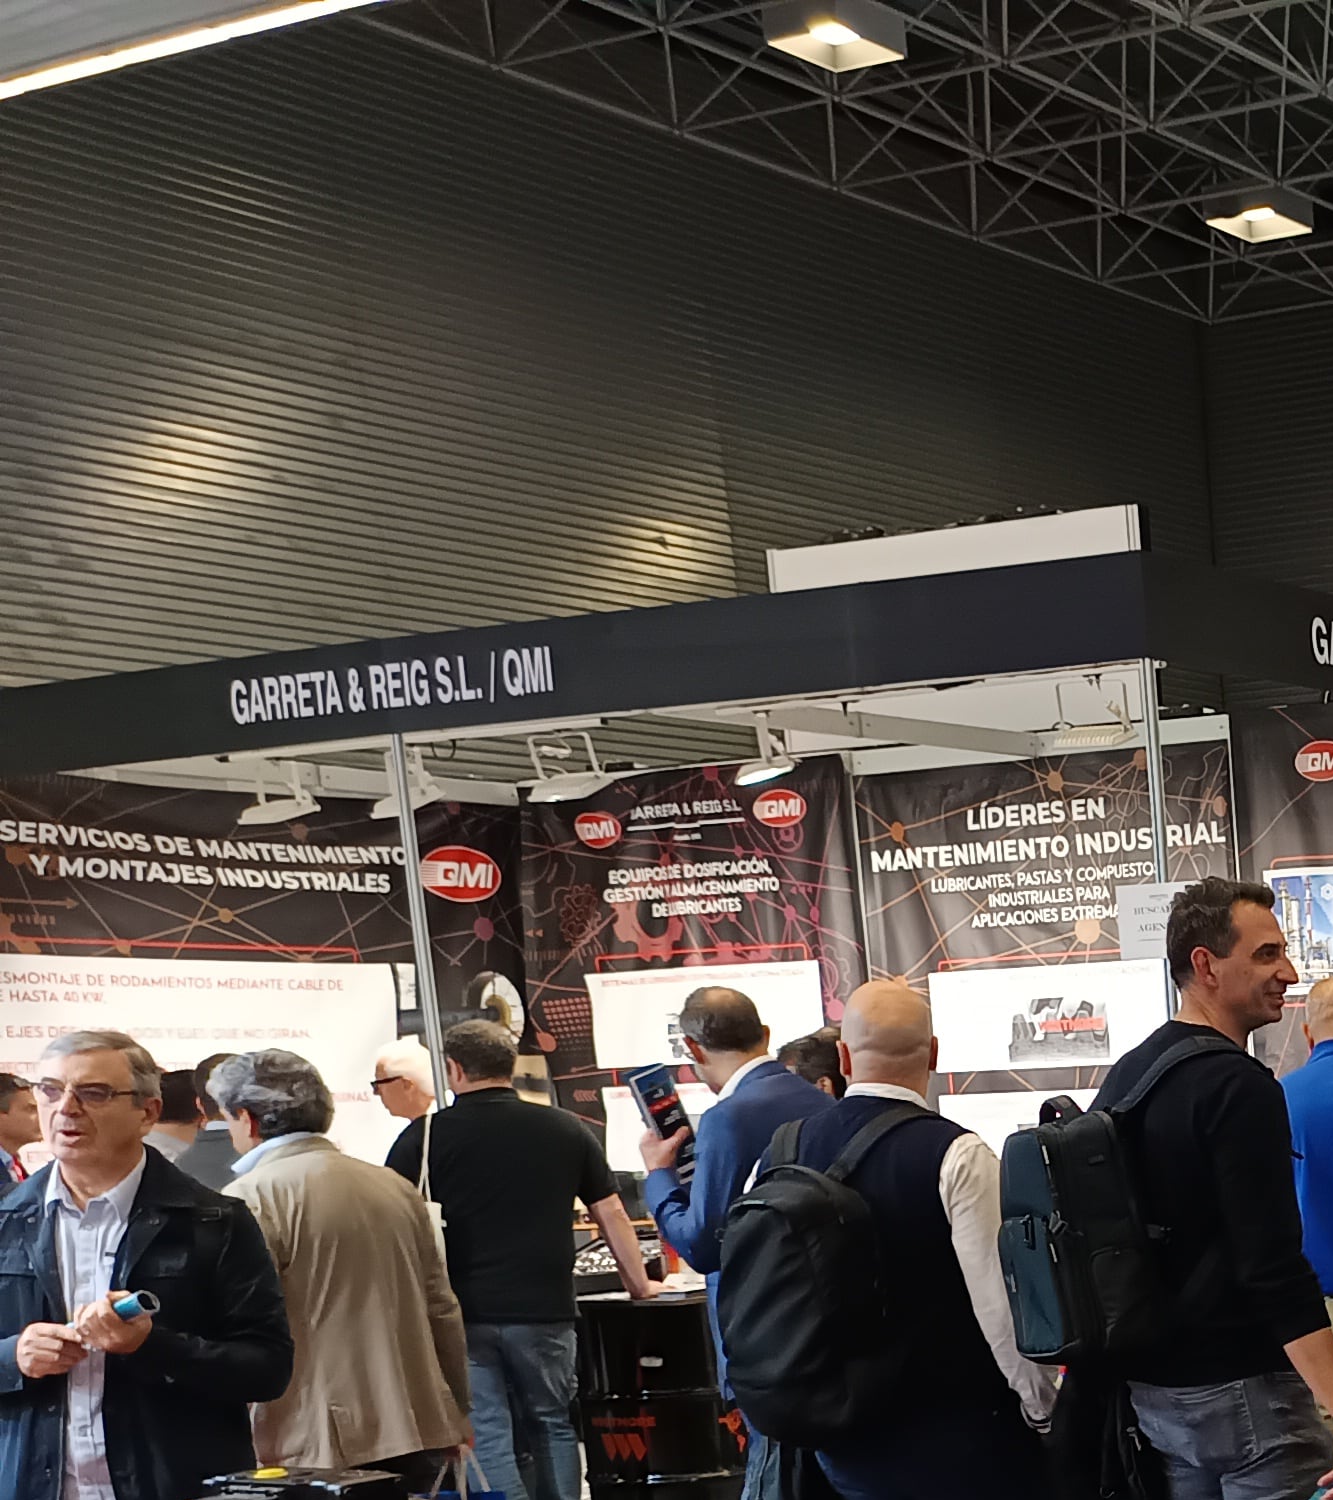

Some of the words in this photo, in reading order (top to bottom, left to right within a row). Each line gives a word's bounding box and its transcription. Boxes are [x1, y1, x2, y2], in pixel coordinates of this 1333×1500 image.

[229, 670, 345, 725] GARRETA
[347, 667, 367, 713] &
[368, 659, 431, 710] REIG
[434, 655, 484, 704] S.L.
[502, 646, 554, 697] QMI
[765, 798, 801, 818] QMI
[965, 799, 1066, 832] LÍDERES
[1070, 797, 1106, 822] EN
[0, 819, 152, 853] SERVICIOS
[153, 834, 195, 857] DE
[199, 837, 406, 866] MANTENIMIENTO
[870, 835, 1070, 873] MANTENIMIENTO
[1075, 820, 1227, 854] INDUSRIAL
[28, 853, 51, 876] Y
[58, 855, 216, 886] MONTAJES
[217, 866, 392, 894] INDUSTRIALES
[435, 860, 494, 890] QMI
[608, 865, 667, 886] EQUIPOS
[930, 871, 1016, 894] LUBRICANTES,
[1016, 868, 1062, 888] PASTAS
[1064, 868, 1074, 883] Y
[603, 882, 664, 904] GESTIÓN
[672, 877, 780, 898] ALMACENAMIENTO
[987, 887, 1074, 909] INDUSTRIALES
[1075, 885, 1111, 902] PARA
[971, 908, 1059, 929] APLICACIONES
[1061, 902, 1119, 922] EXTREMA
[1137, 922, 1167, 932] AGEN
[9, 990, 60, 1003] HASTA
[87, 974, 105, 987] DE
[111, 975, 214, 990] RODAMIENTOS
[217, 978, 285, 991] MEDIANTE
[287, 978, 325, 992] CABLE
[326, 979, 345, 992] DE
